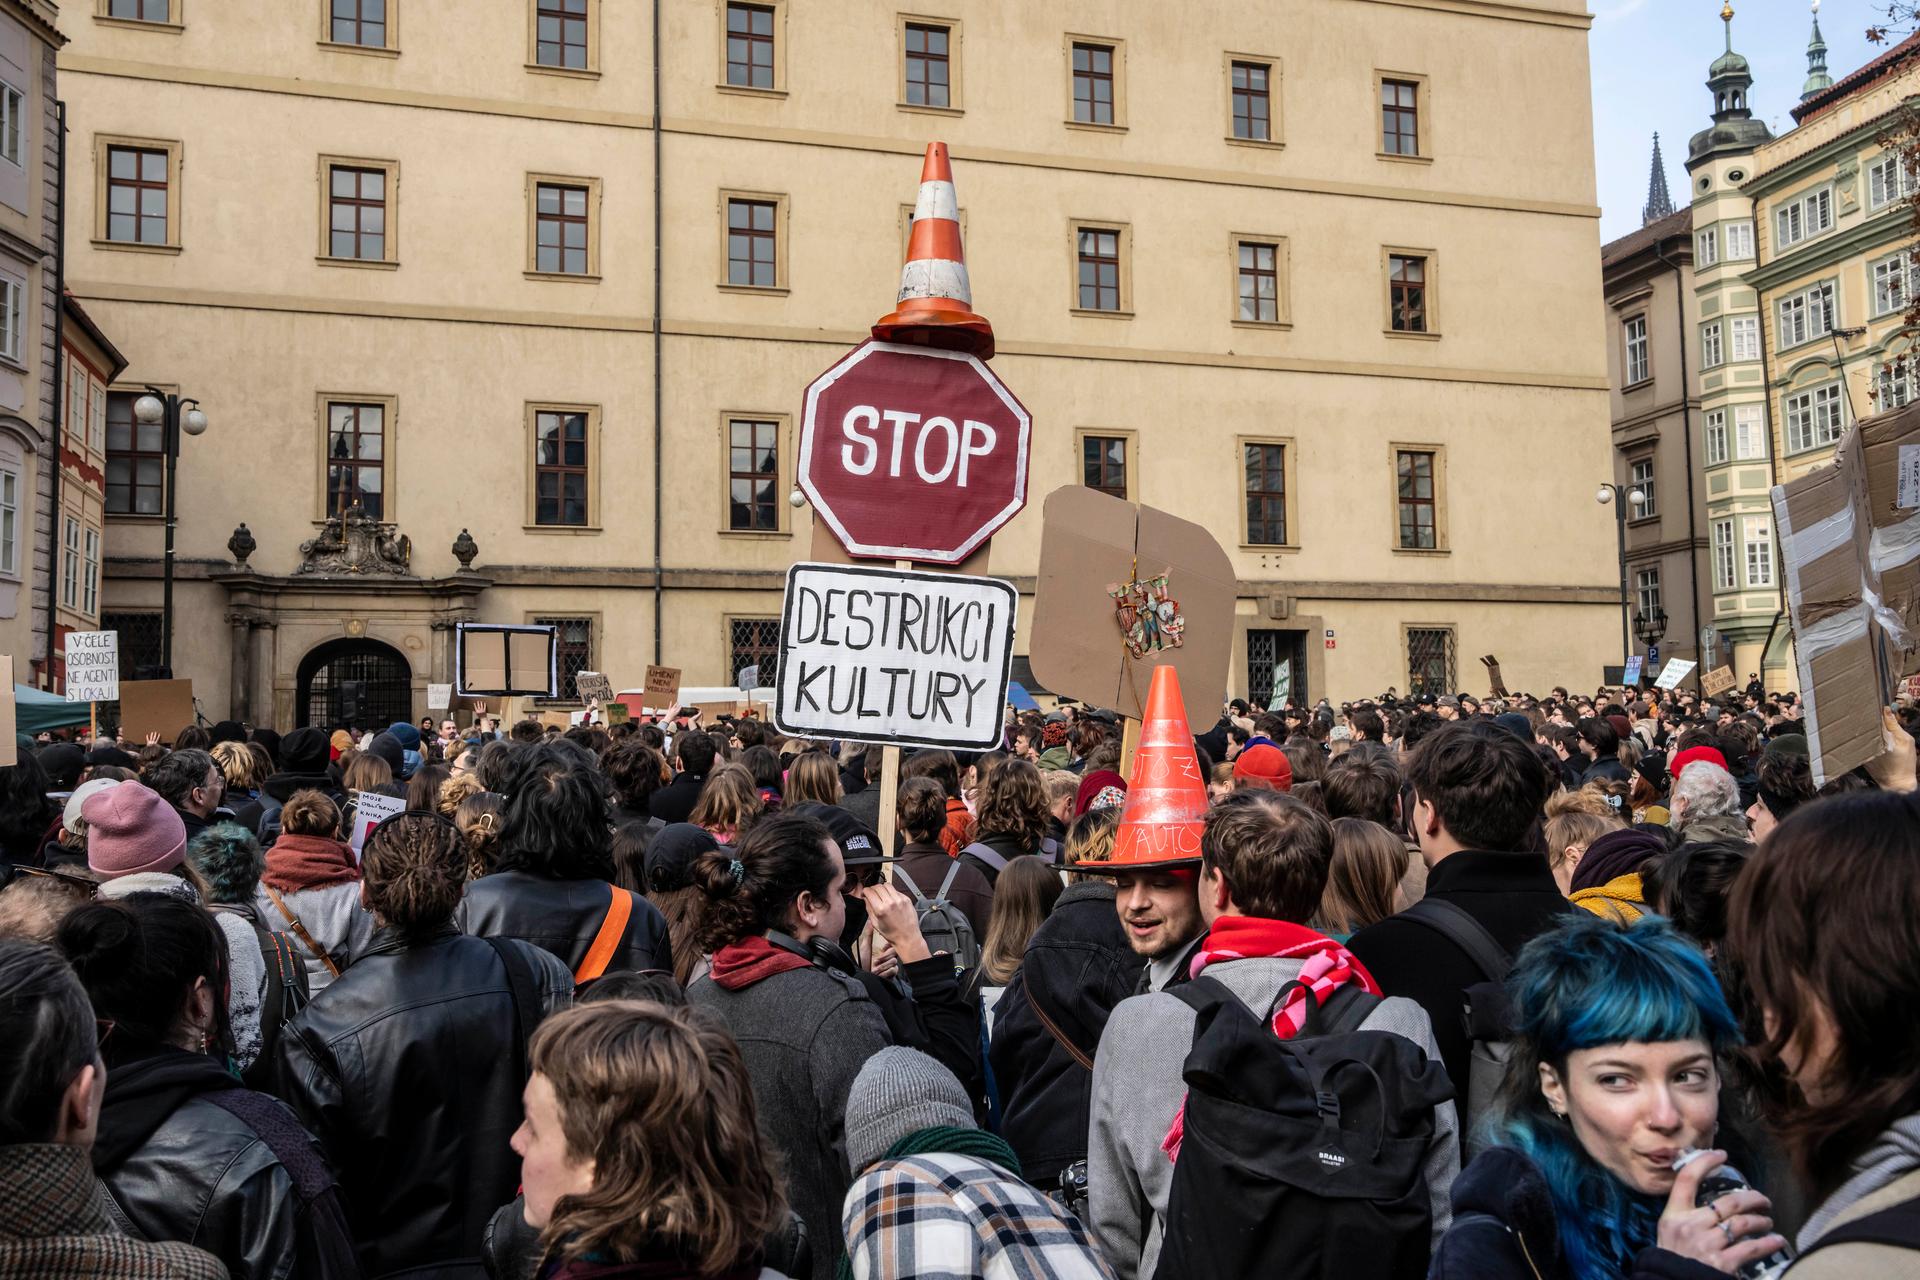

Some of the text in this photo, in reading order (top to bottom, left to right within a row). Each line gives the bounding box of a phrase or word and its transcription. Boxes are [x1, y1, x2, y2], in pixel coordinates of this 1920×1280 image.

[841, 405, 997, 487] STOP
[797, 586, 995, 662] DESTRUKCI
[73, 633, 111, 648] V ČELE
[67, 651, 116, 666] OSOBNOST
[1650, 648, 1656, 659] P
[68, 670, 80, 684] NE
[68, 686, 113, 701] S LOKAJI
[794, 661, 986, 729] KULTURY
[362, 794, 383, 802] MOJE
